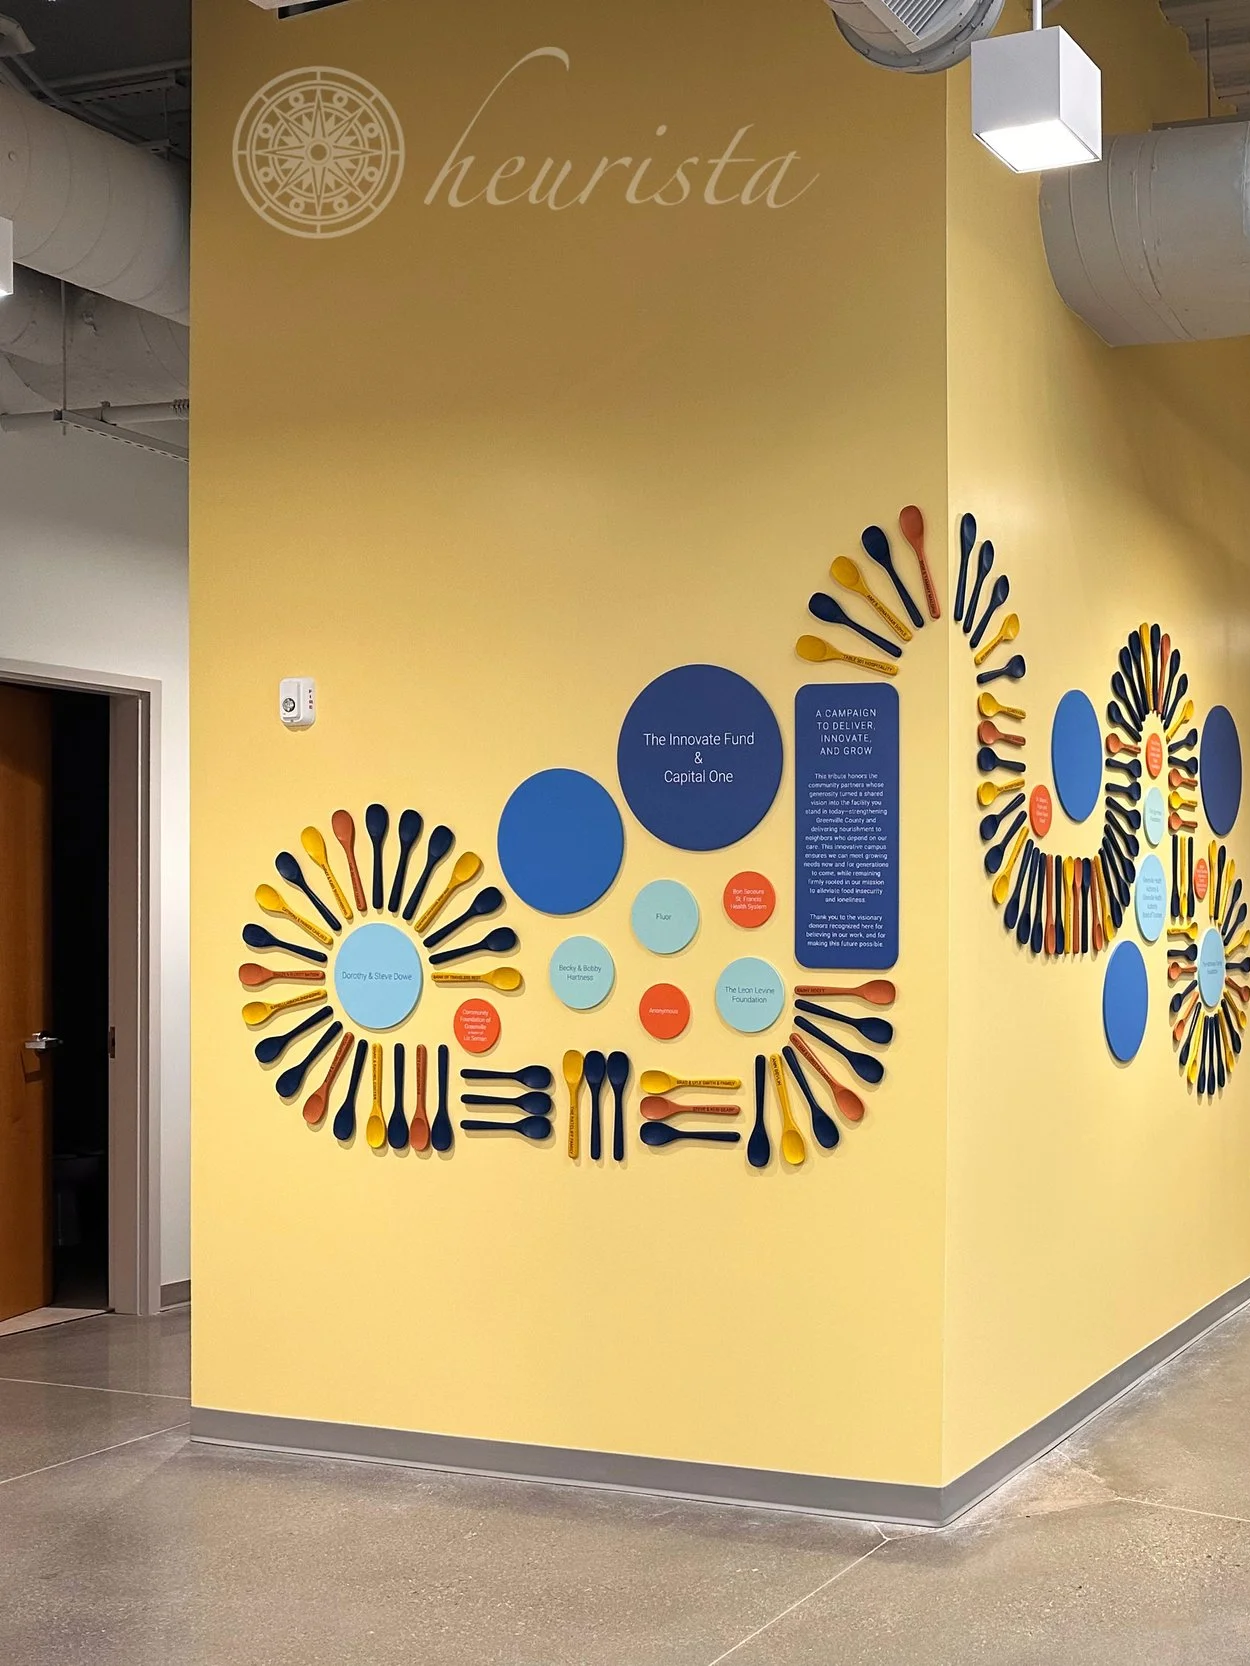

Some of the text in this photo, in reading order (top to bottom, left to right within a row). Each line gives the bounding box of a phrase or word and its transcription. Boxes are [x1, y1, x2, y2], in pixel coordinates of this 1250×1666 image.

[825, 709, 876, 717] CAMPAIGN
[817, 721, 875, 730] TO DELIVER,
[644, 732, 754, 745] The Innovate Fund
[821, 734, 871, 742] INNOVATE,
[844, 747, 872, 755] GROW
[694, 752, 703, 764] &
[664, 770, 733, 785] Capital One
[342, 972, 367, 981] Dorothy
